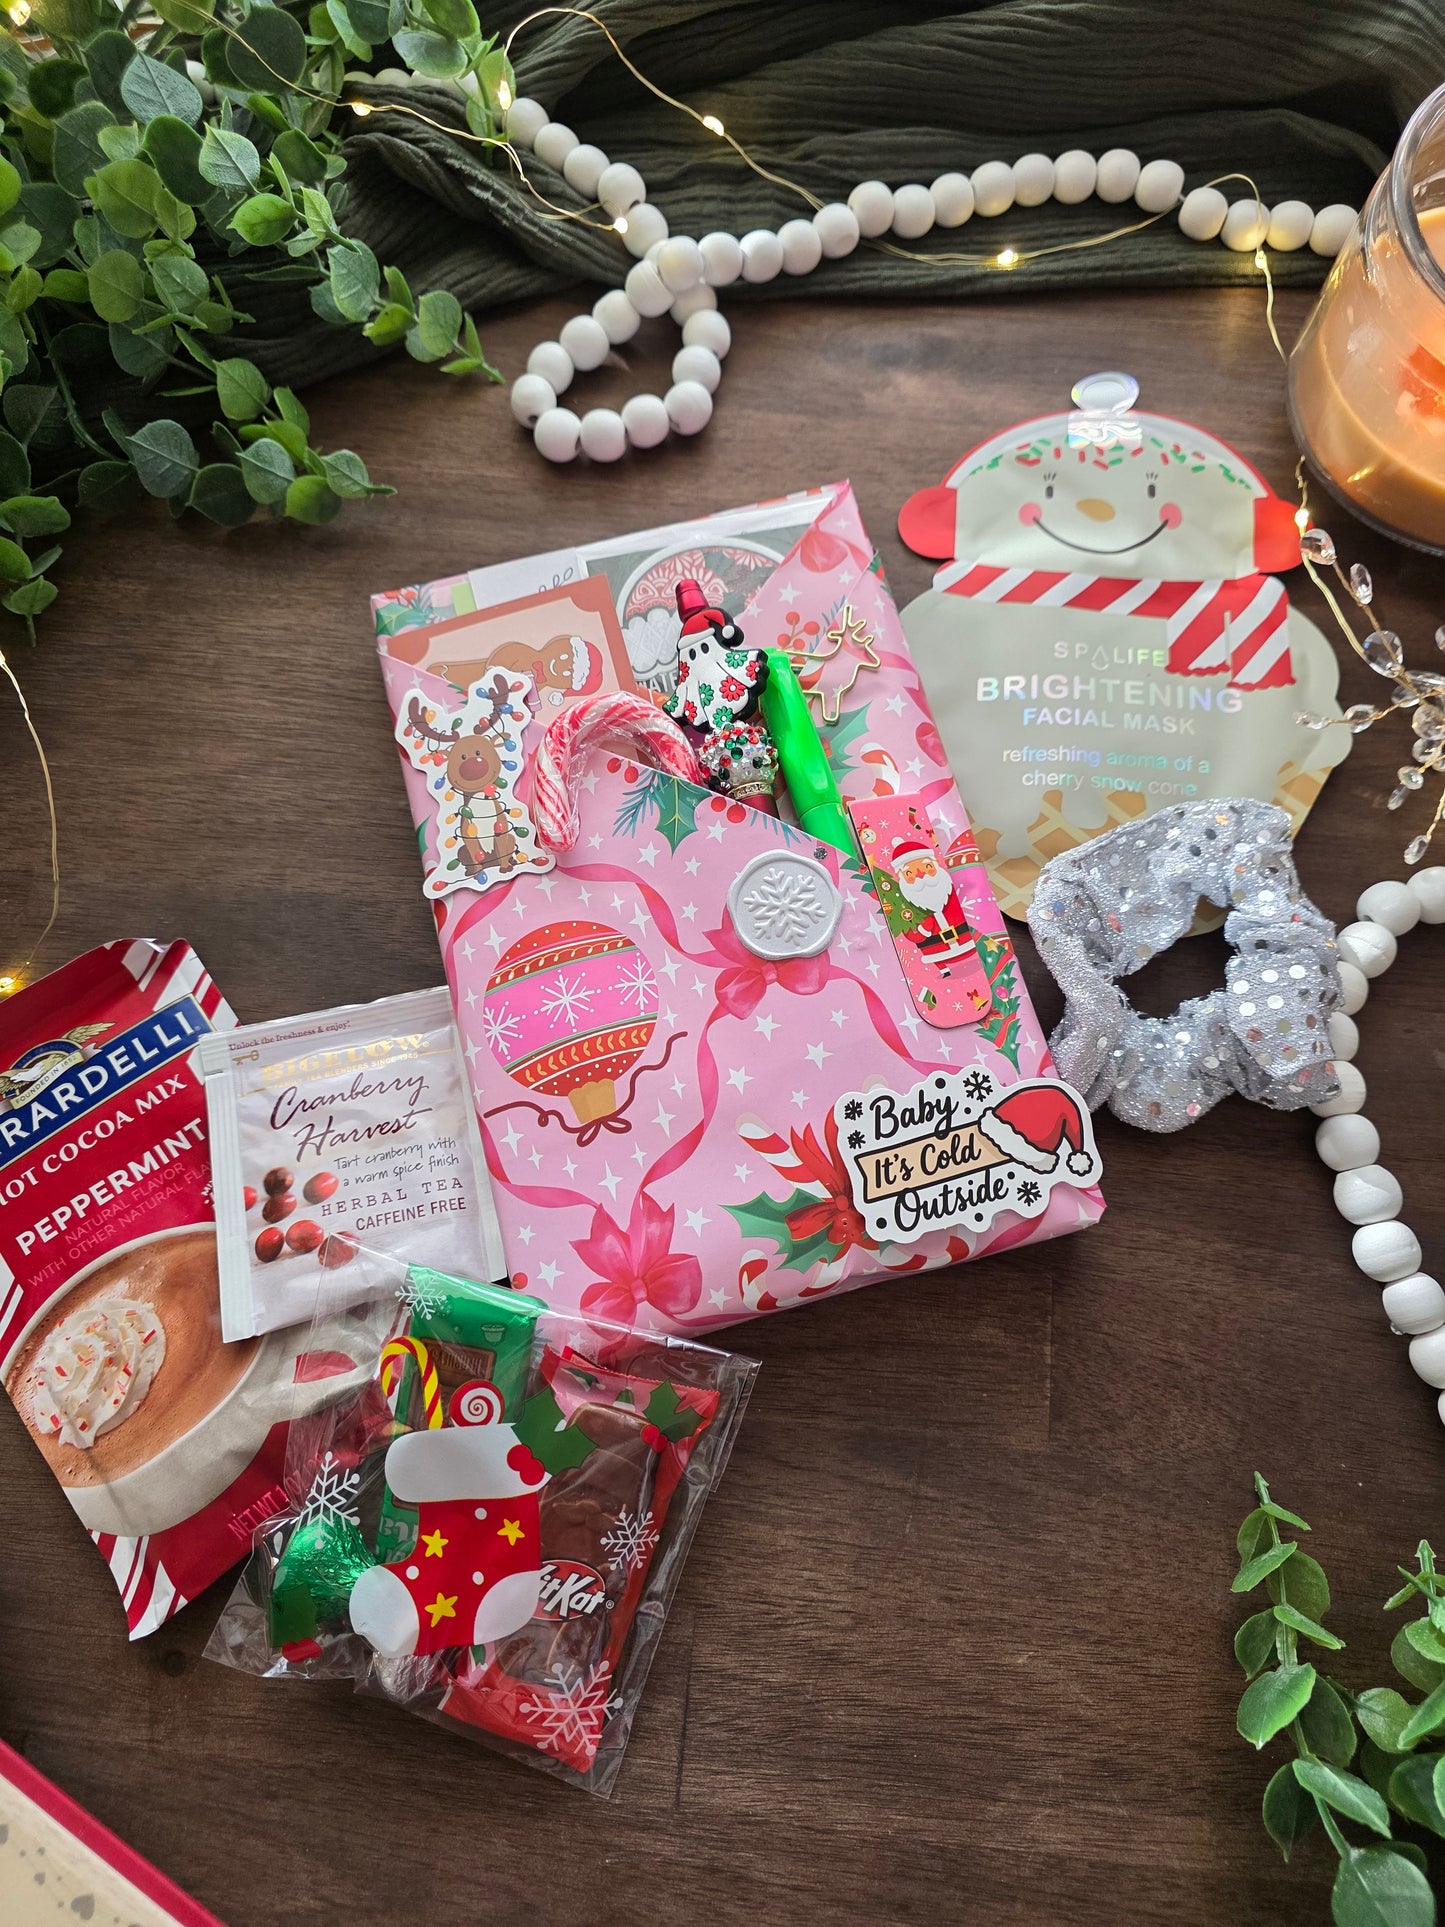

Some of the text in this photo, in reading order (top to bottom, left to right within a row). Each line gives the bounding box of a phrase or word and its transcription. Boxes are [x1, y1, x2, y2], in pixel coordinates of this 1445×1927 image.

[976, 673, 1243, 714] BRIGHTENING
[1022, 707, 1196, 735] FACIAL MASK
[1002, 746, 1210, 774] refreshing aroma of a
[1022, 769, 1198, 796] cherry snow cone
[229, 1039, 260, 1050] Unlock
[261, 1036, 274, 1045] the
[275, 1028, 315, 1042] freshness
[261, 1033, 424, 1082] BIGELOW
[371, 1056, 397, 1067] SINCE
[0, 1011, 194, 1147] RARDELLI
[15, 1075, 50, 1105] FOUNDED
[50, 1067, 59, 1077] IN
[270, 1072, 430, 1131] Cranberry
[42, 1110, 135, 1173] COCOA
[135, 1074, 187, 1115] MIX
[293, 1107, 433, 1163] Harvest
[869, 1089, 959, 1140] Baby
[333, 1137, 456, 1170] Tart cranberry with
[343, 1153, 460, 1187] a warm spice finish
[875, 1132, 982, 1188] It's Cold
[15, 1117, 205, 1255] PEPPERMINT
[64, 1199, 130, 1245] NATURAL
[131, 1162, 186, 1201] FLAVOR
[321, 1177, 463, 1216] HERBAL TEA
[894, 1165, 1009, 1232] Outside
[27, 1256, 67, 1287] WITH
[68, 1223, 119, 1260] OTHER
[118, 1183, 183, 1228] NATURAL
[184, 1161, 212, 1184] FLA
[355, 1197, 467, 1231] CAFFEINE FREE
[228, 1508, 259, 1541] NET
[253, 1491, 280, 1519] WT
